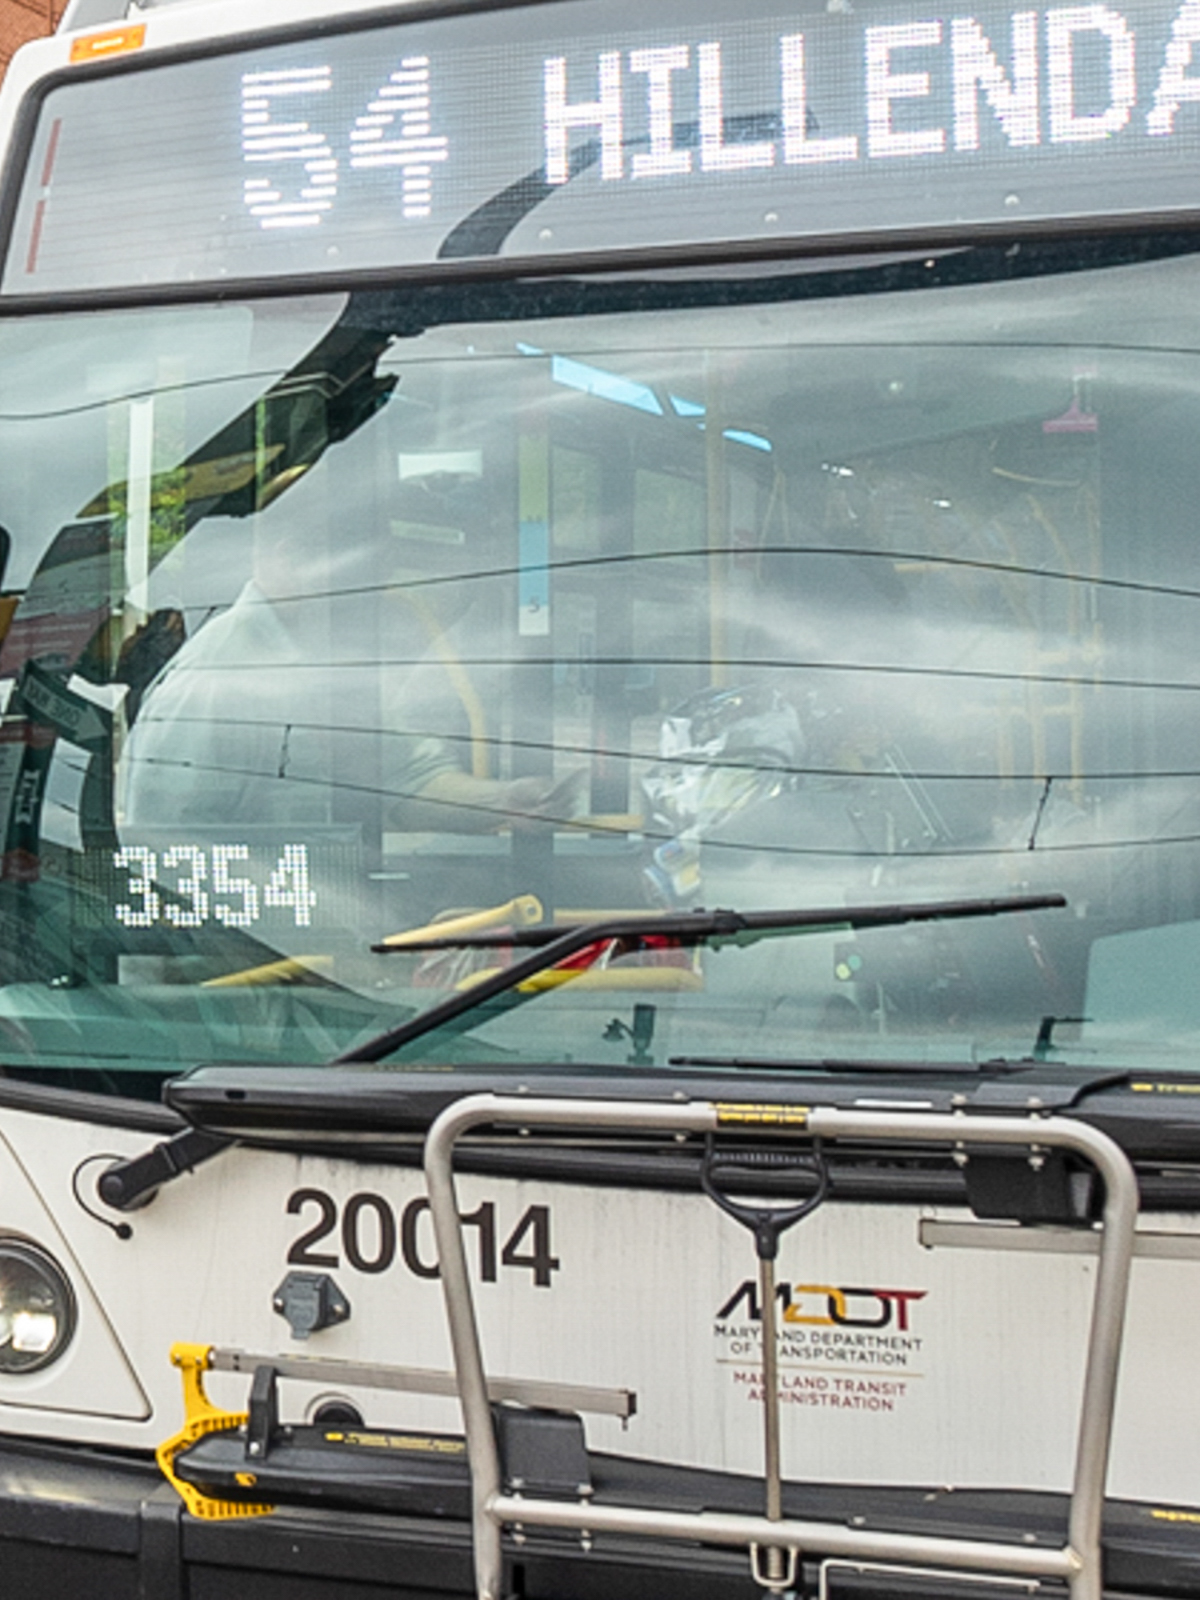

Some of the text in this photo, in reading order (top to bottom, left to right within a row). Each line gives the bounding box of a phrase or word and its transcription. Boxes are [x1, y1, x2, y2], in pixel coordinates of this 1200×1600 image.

[241, 0, 1200, 219] 54 HILLENDA
[113, 844, 317, 927] 3354
[286, 1187, 560, 1288] 20014
[730, 1341, 752, 1355] OF
[809, 1331, 923, 1352] DEPARTMENT
[832, 1378, 907, 1397] TRANSIT
